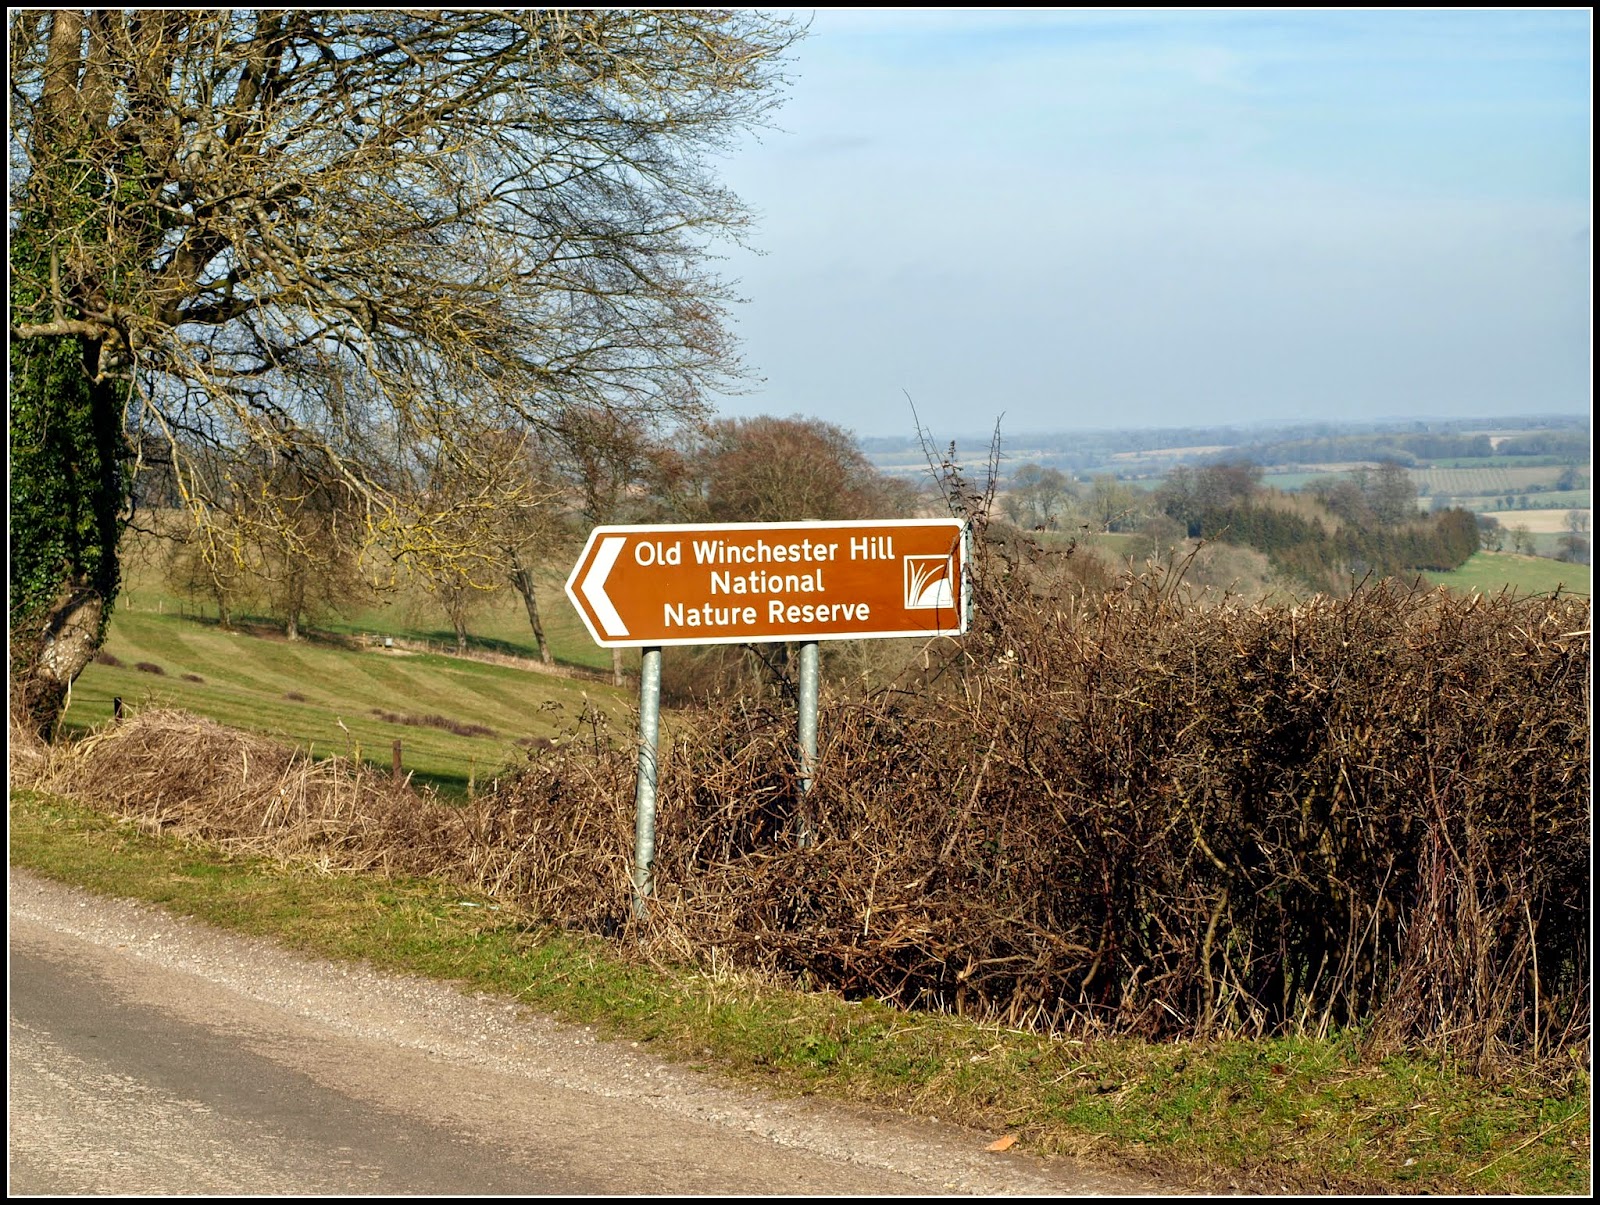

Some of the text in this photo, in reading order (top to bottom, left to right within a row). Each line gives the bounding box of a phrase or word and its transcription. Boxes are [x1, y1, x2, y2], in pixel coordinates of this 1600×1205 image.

[634, 536, 896, 567] Old Winchester Hill
[710, 568, 825, 595] National
[664, 599, 870, 627] Nature Reserve
